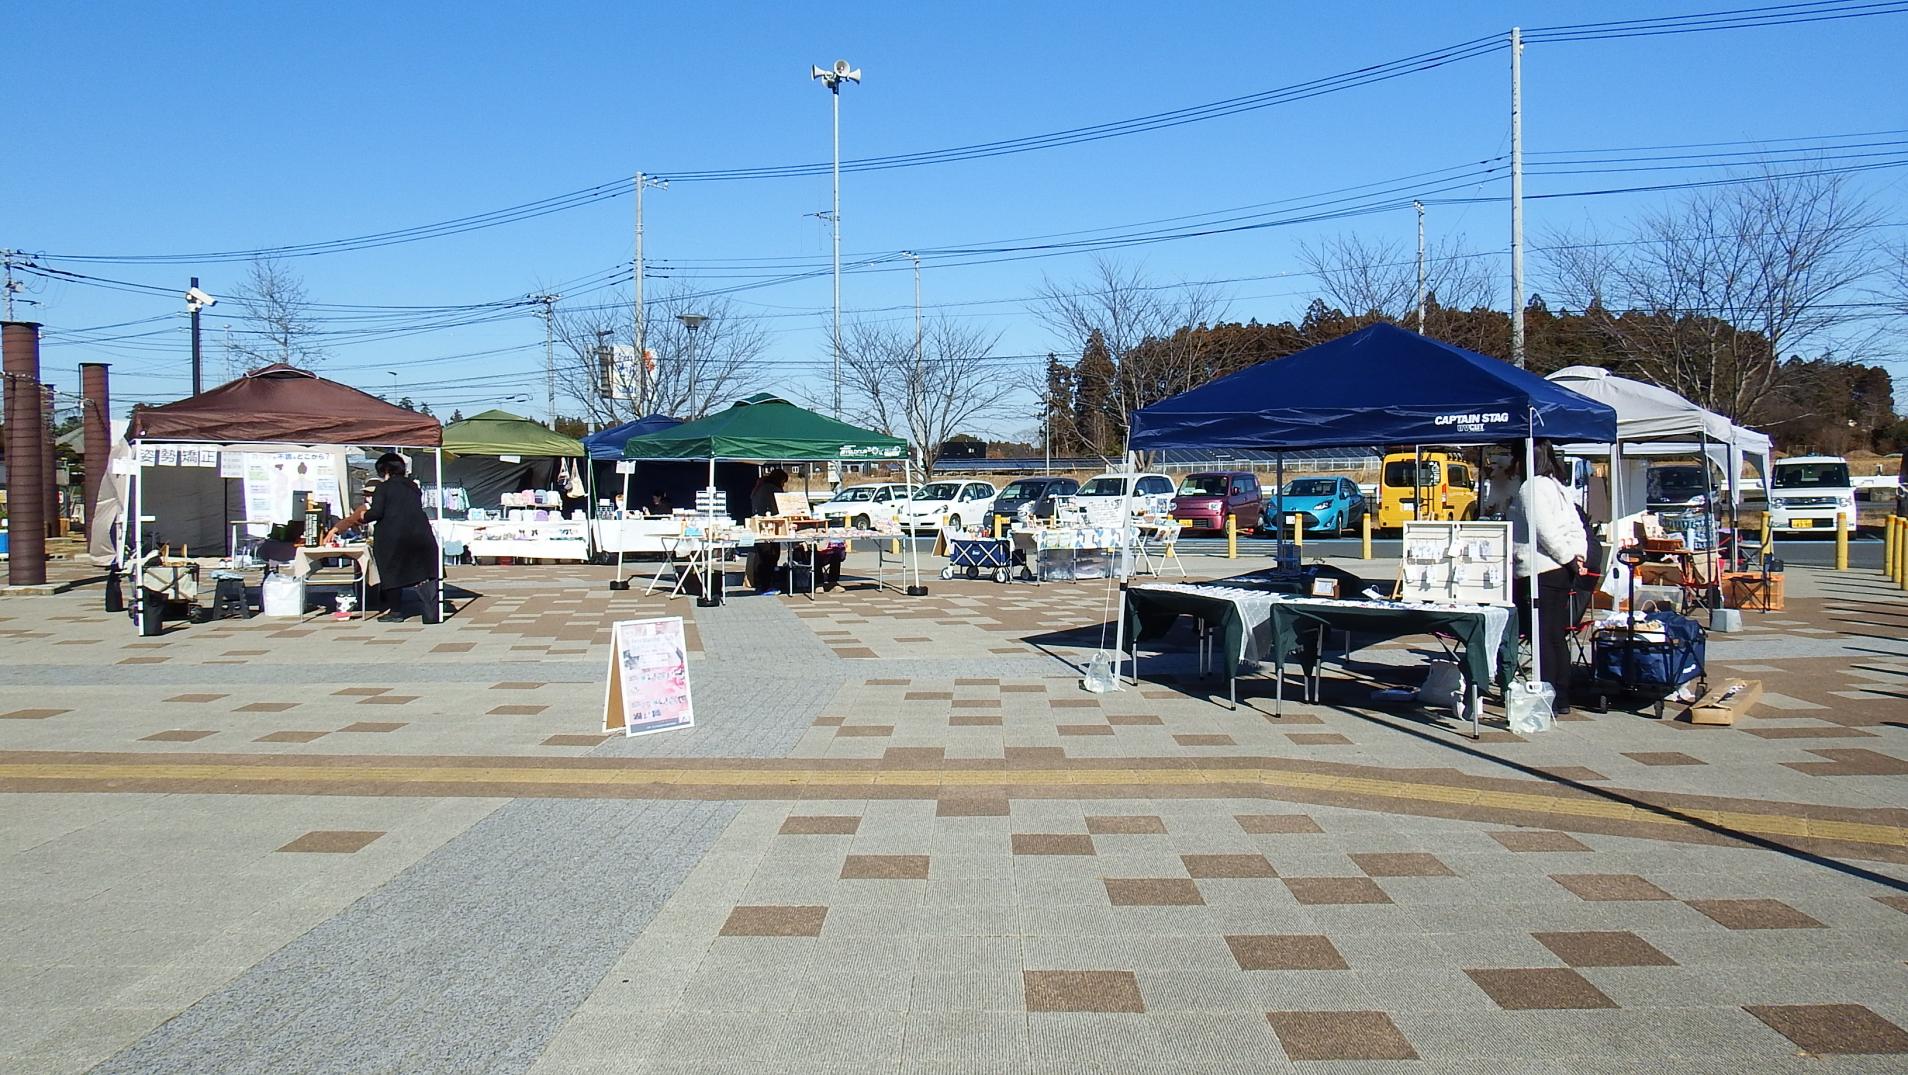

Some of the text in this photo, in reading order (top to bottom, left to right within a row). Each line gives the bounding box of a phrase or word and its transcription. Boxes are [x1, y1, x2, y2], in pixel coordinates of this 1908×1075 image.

[1434, 412, 1509, 425] CAPTAIN STAG
[141, 448, 215, 462] 姿勢矯正
